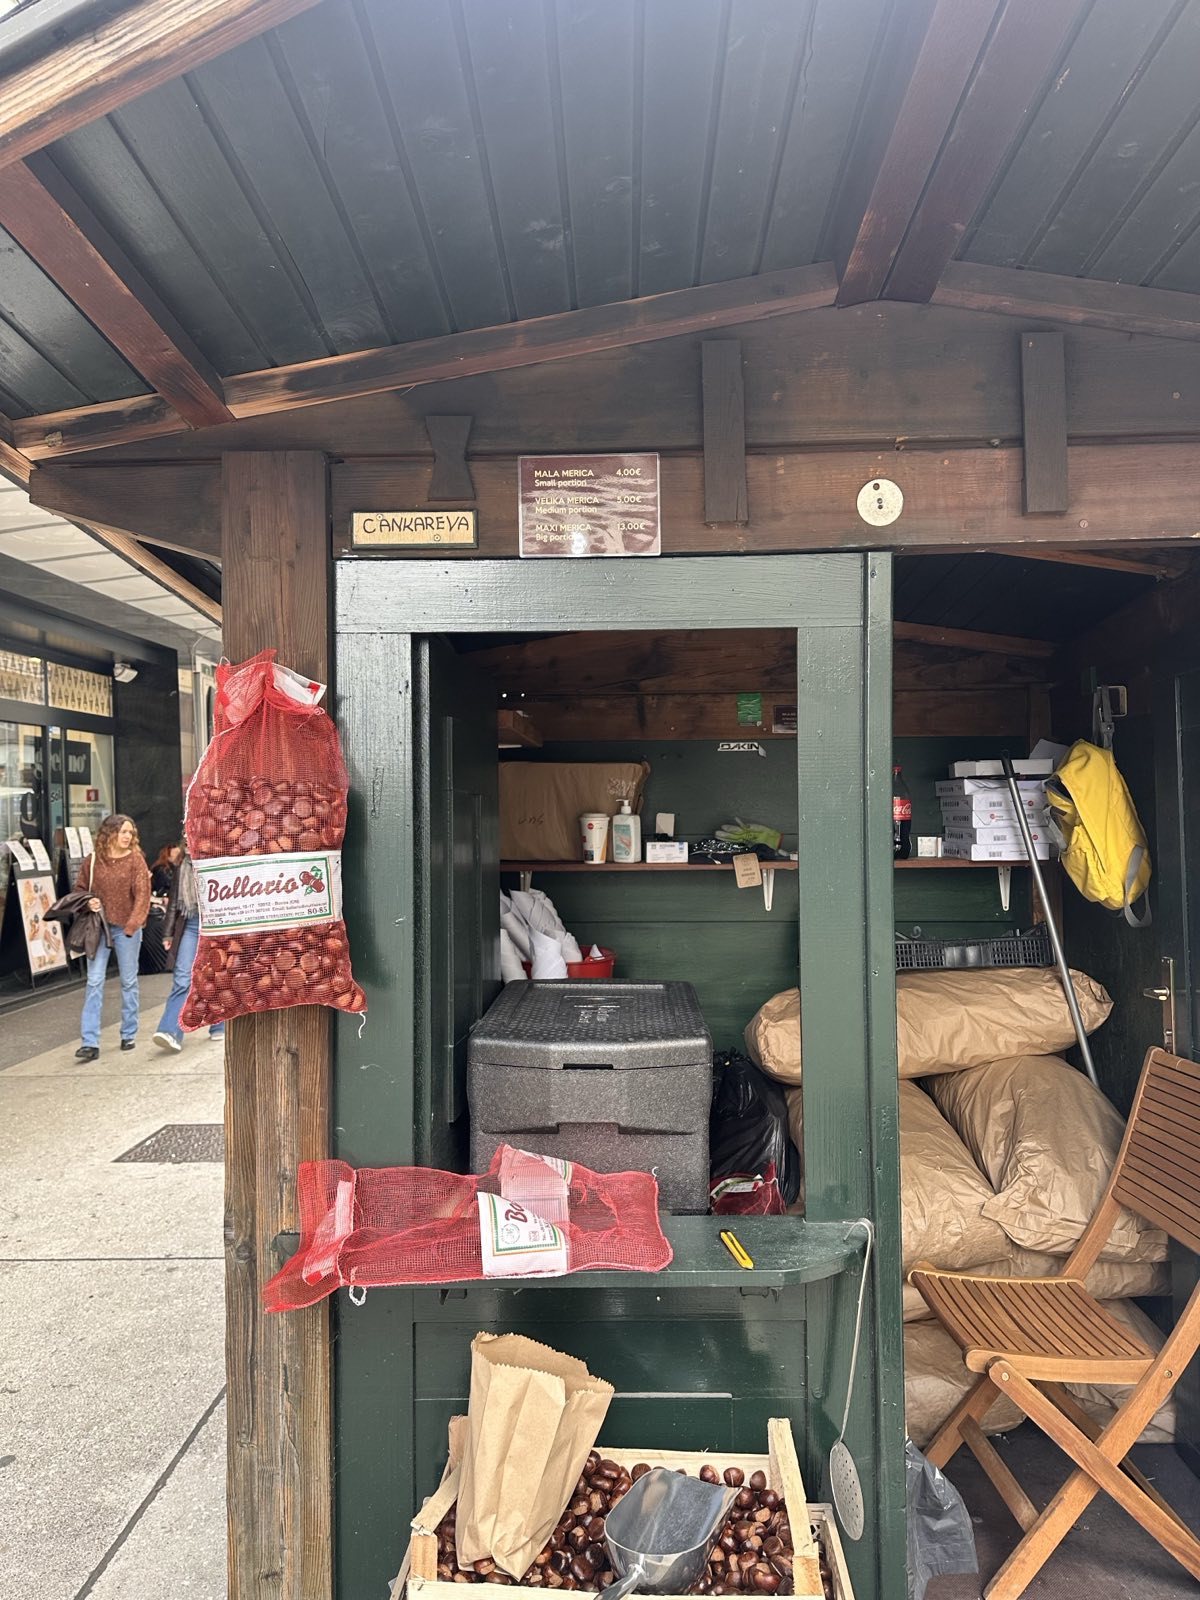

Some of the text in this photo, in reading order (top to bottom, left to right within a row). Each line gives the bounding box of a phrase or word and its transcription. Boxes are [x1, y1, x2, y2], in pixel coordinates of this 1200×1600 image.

[534, 470, 560, 478] MALA
[561, 469, 594, 477] MERICA
[557, 480, 587, 488] portion
[363, 516, 469, 534] CANKAREVA
[535, 534, 548, 542] Big
[207, 872, 299, 903] Ballario
